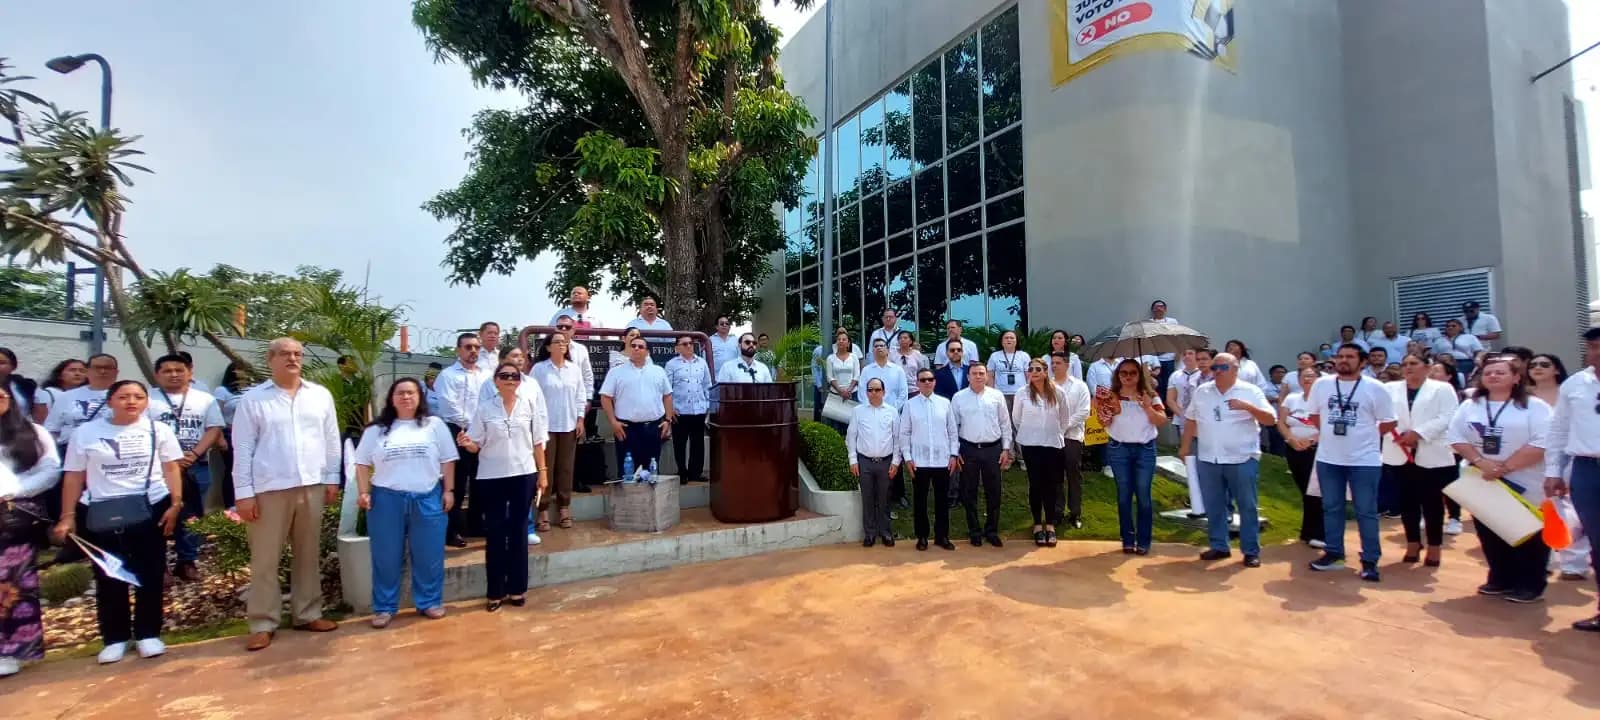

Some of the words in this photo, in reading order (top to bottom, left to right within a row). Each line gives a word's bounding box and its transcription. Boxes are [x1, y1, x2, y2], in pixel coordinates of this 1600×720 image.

[1076, 0, 1113, 24] VOTO
[1104, 11, 1131, 30] NO
[590, 345, 603, 353] DE
